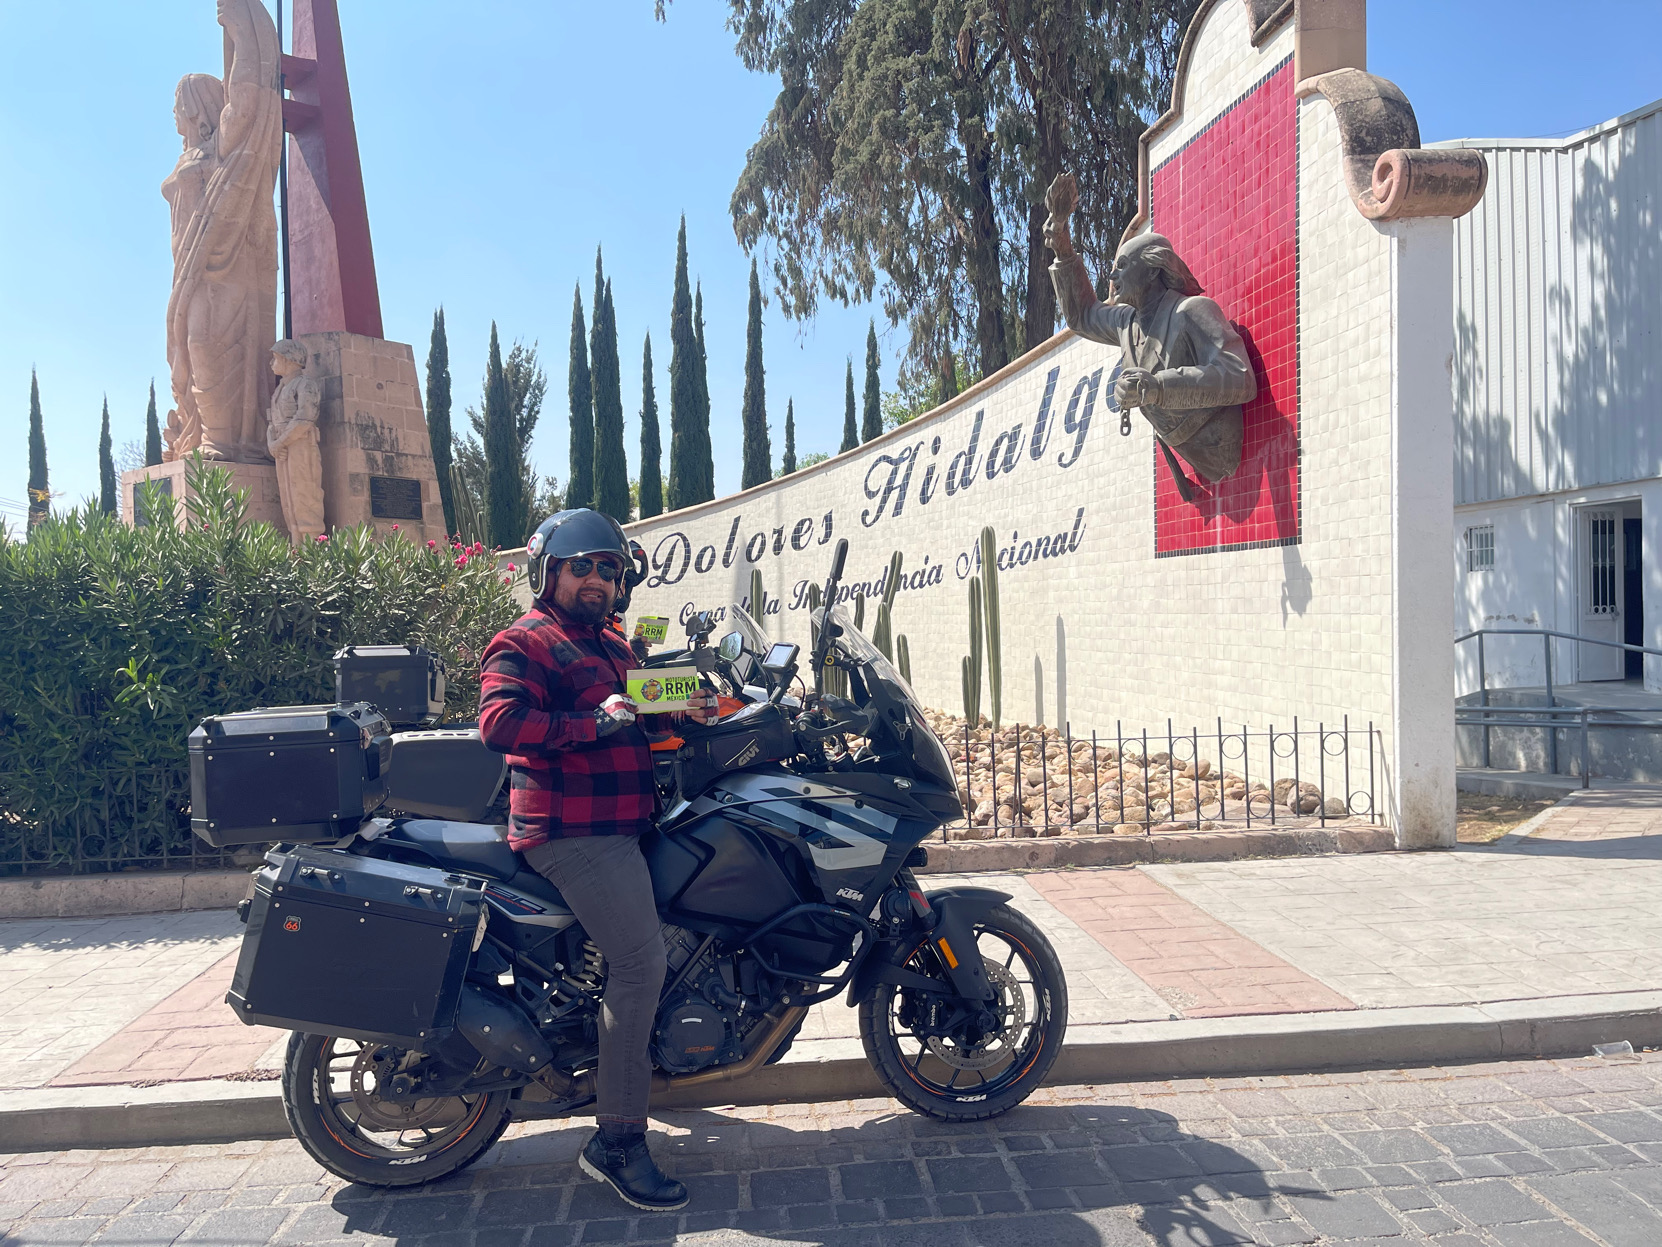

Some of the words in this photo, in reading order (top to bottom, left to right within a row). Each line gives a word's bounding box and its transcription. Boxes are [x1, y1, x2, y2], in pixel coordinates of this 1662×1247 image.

[646, 508, 834, 588] Dolores
[679, 601, 728, 627] Ca
[956, 506, 1087, 580] Ncional
[645, 627, 664, 637] RRM
[665, 681, 697, 695] RRM
[738, 744, 760, 767] GIVI
[836, 887, 864, 902] KTM
[285, 921, 298, 931] 66
